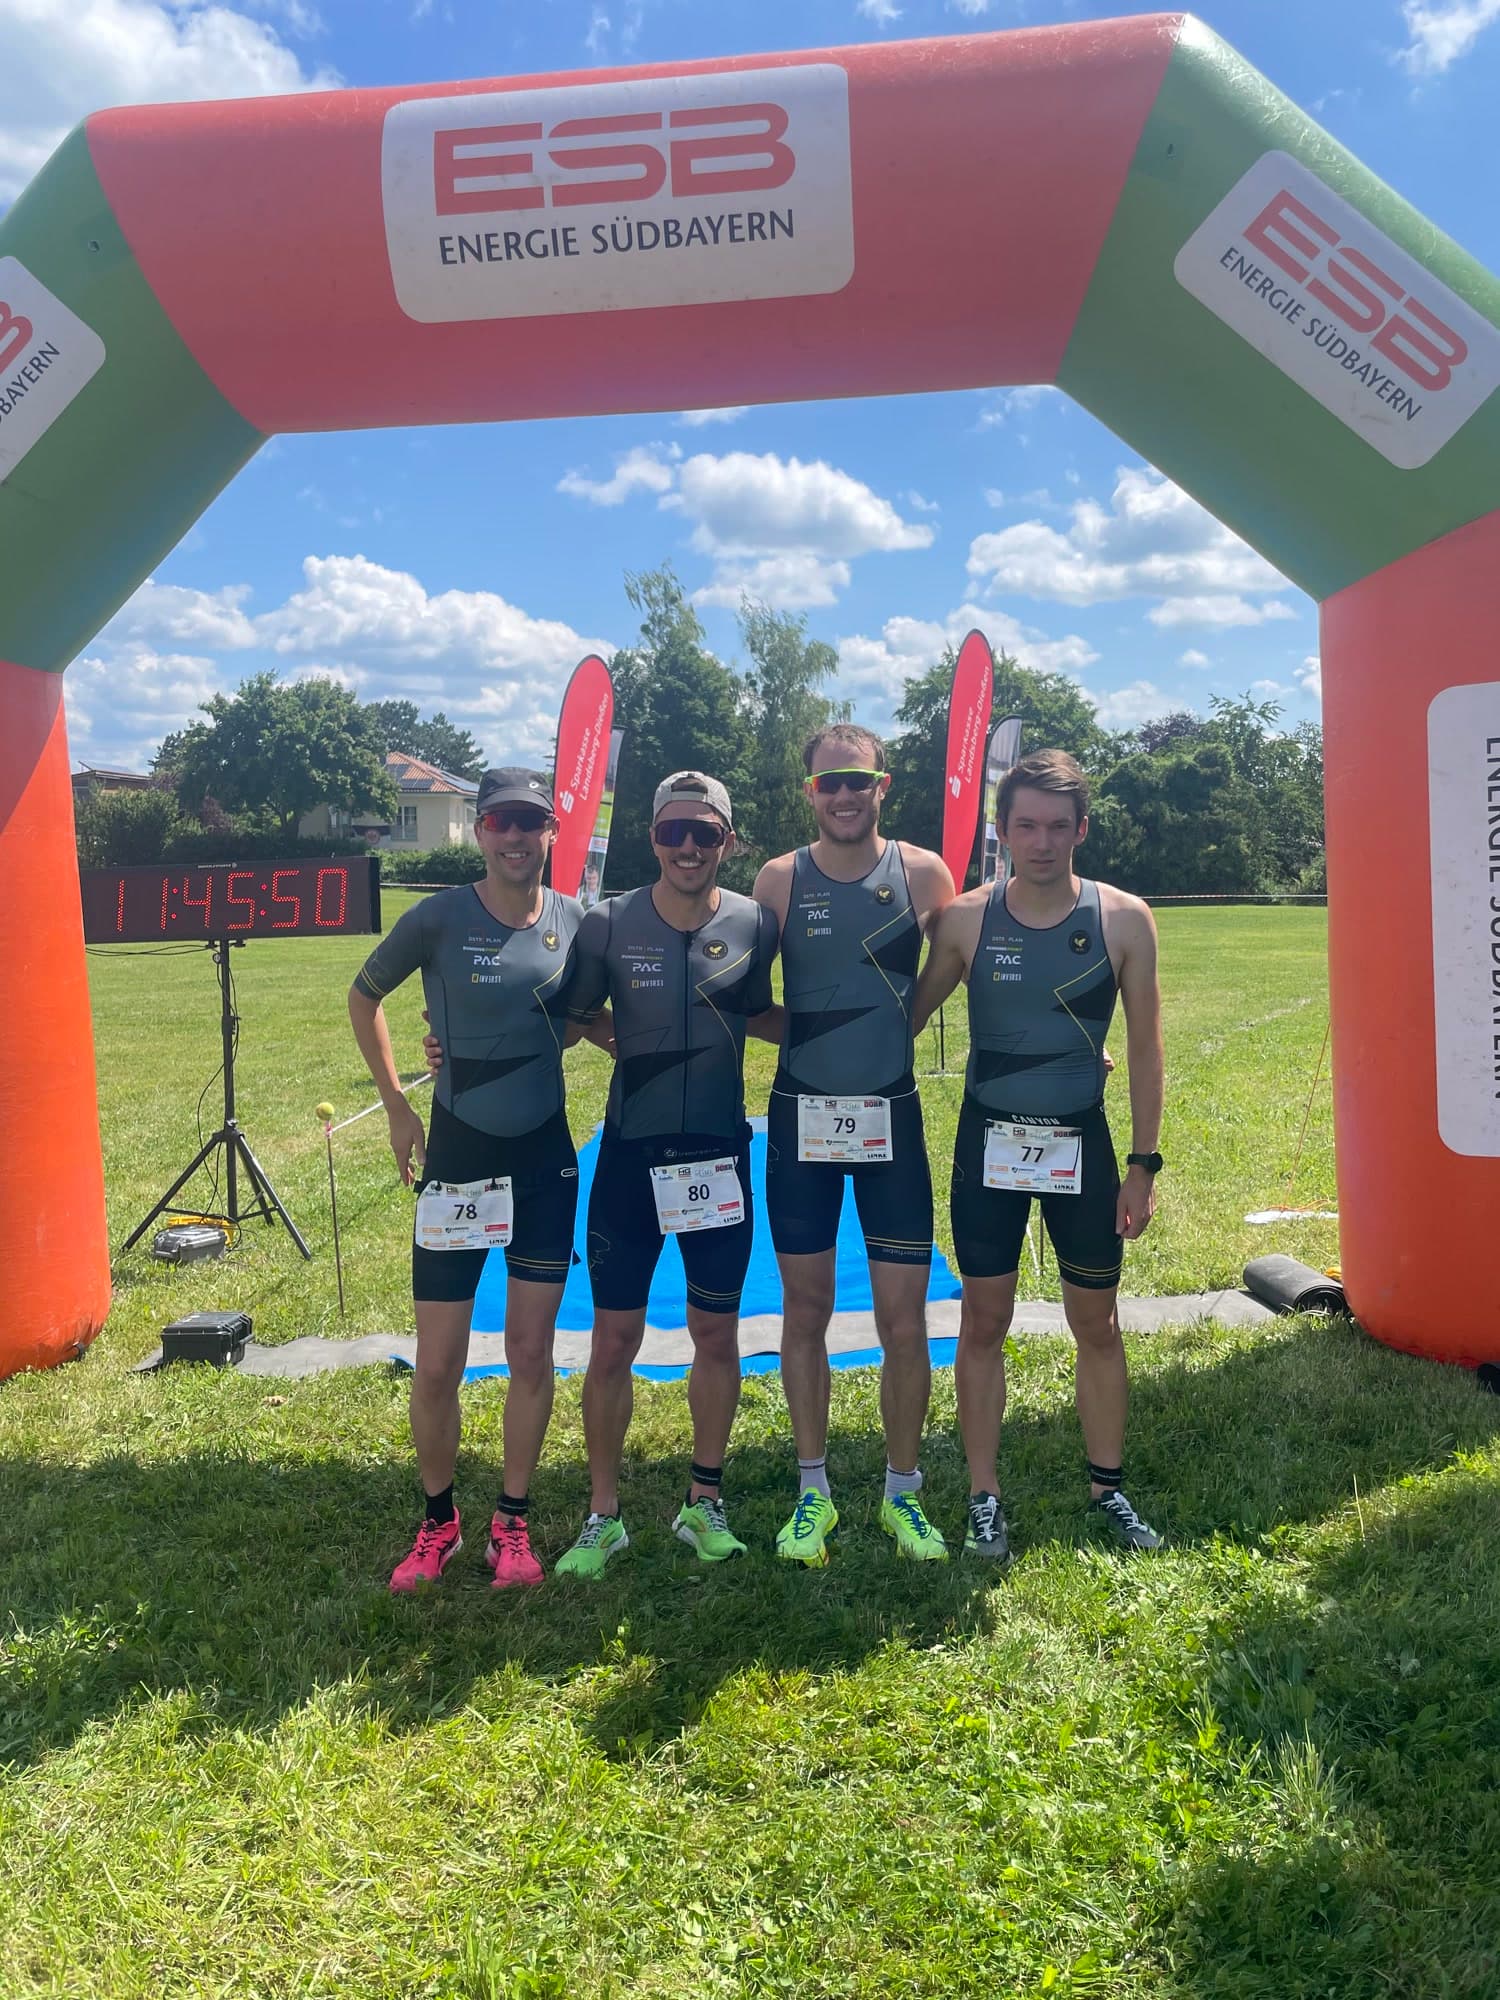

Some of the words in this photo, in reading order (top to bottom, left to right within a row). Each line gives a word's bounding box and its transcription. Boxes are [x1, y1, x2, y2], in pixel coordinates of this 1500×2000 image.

[433, 102, 796, 217] ESB
[438, 226, 580, 265] ENERGIE
[591, 208, 795, 254] SÜDBAYERN
[1242, 188, 1469, 392] ESB
[1219, 247, 1306, 325] ENERGIE
[1302, 317, 1423, 421] SÜDBAYERN
[0, 341, 60, 424] BAYERN
[957, 706, 974, 774] Sparkasse
[570, 727, 592, 791] Sparkasse
[117, 867, 348, 932] 11:45:50
[807, 909, 831, 920] PAC
[473, 955, 501, 966] PAC
[632, 962, 662, 972] PAC
[995, 954, 1022, 965] PAC
[833, 1117, 856, 1134] 79
[1011, 1114, 1060, 1126] CANYON
[1021, 1145, 1045, 1163] 77
[688, 1184, 710, 1202] 80
[454, 1204, 477, 1220] 78
